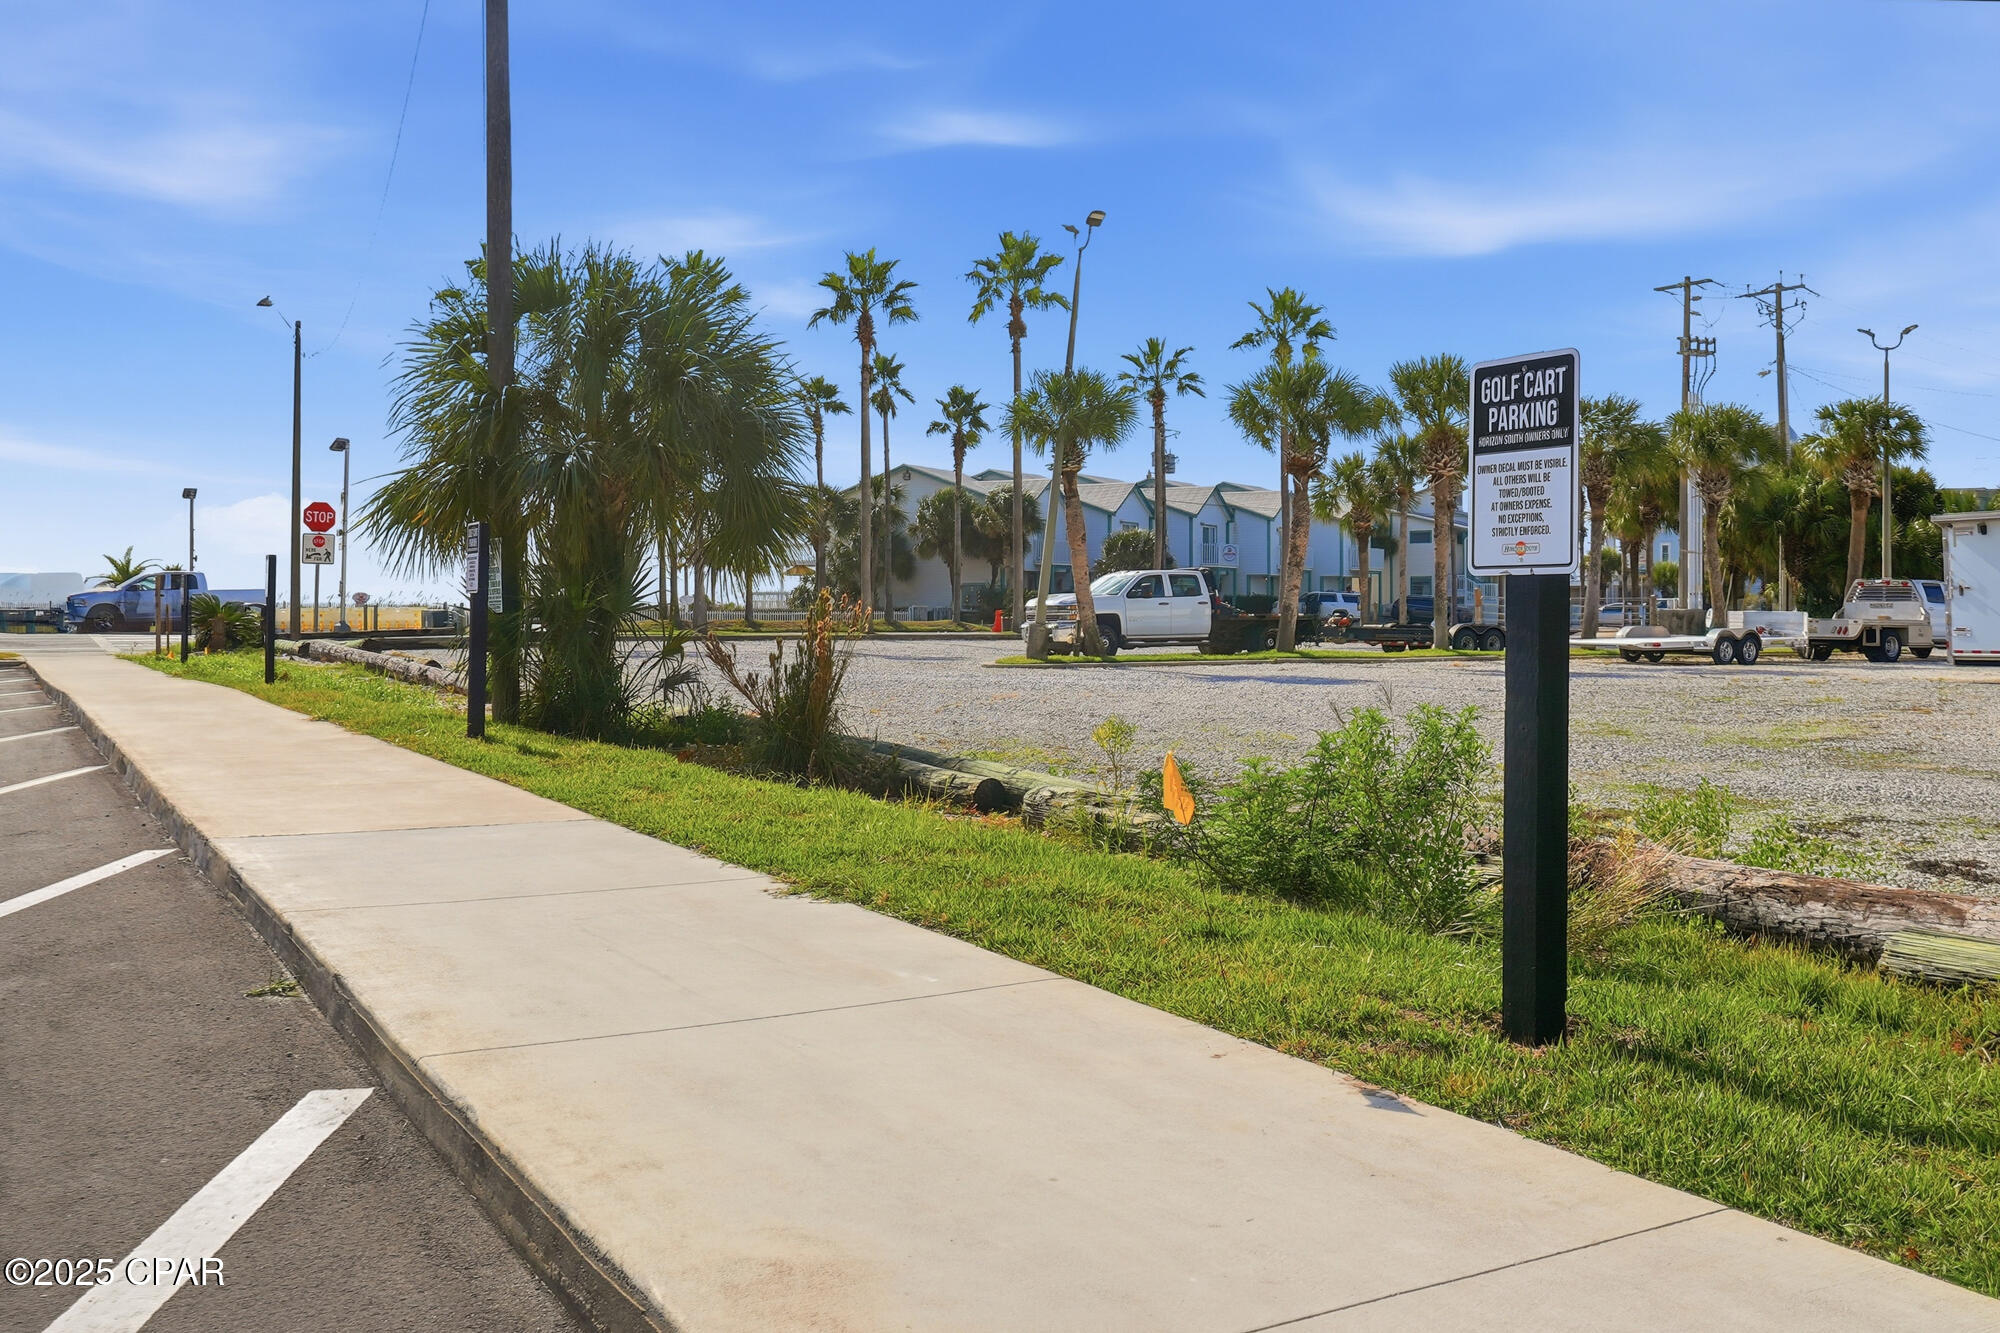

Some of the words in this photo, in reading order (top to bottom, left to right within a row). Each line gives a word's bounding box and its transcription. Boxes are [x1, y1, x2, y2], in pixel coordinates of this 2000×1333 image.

[1481, 374, 1520, 404] GOLF
[1523, 367, 1567, 398] CART
[1488, 400, 1557, 433] PARKING
[1478, 434, 1503, 448] HORIZON
[1504, 432, 1523, 445] SOUTH
[1524, 430, 1550, 443] OWNERS
[1551, 427, 1569, 440] ONLY
[1477, 464, 1497, 475] OWNER
[1498, 462, 1516, 473] DECAL
[1517, 460, 1534, 471] MUST
[1535, 459, 1543, 470] BE
[1543, 457, 1568, 469] VISIBLE.
[1493, 476, 1503, 486] ALL
[1504, 474, 1527, 486] OTHERS
[1527, 473, 1542, 483] WILL
[1543, 472, 1551, 482] BE
[1499, 485, 1545, 498] TOWED/BOOTED
[1491, 502, 1498, 511] AT
[1499, 500, 1523, 511] OWNERS
[1524, 498, 1552, 510] EXPENSE.
[305, 510, 334, 523] STOP
[1498, 514, 1506, 524] NO
[1492, 526, 1518, 537] STRICTLY
[1519, 525, 1551, 536] ENFORCED.
